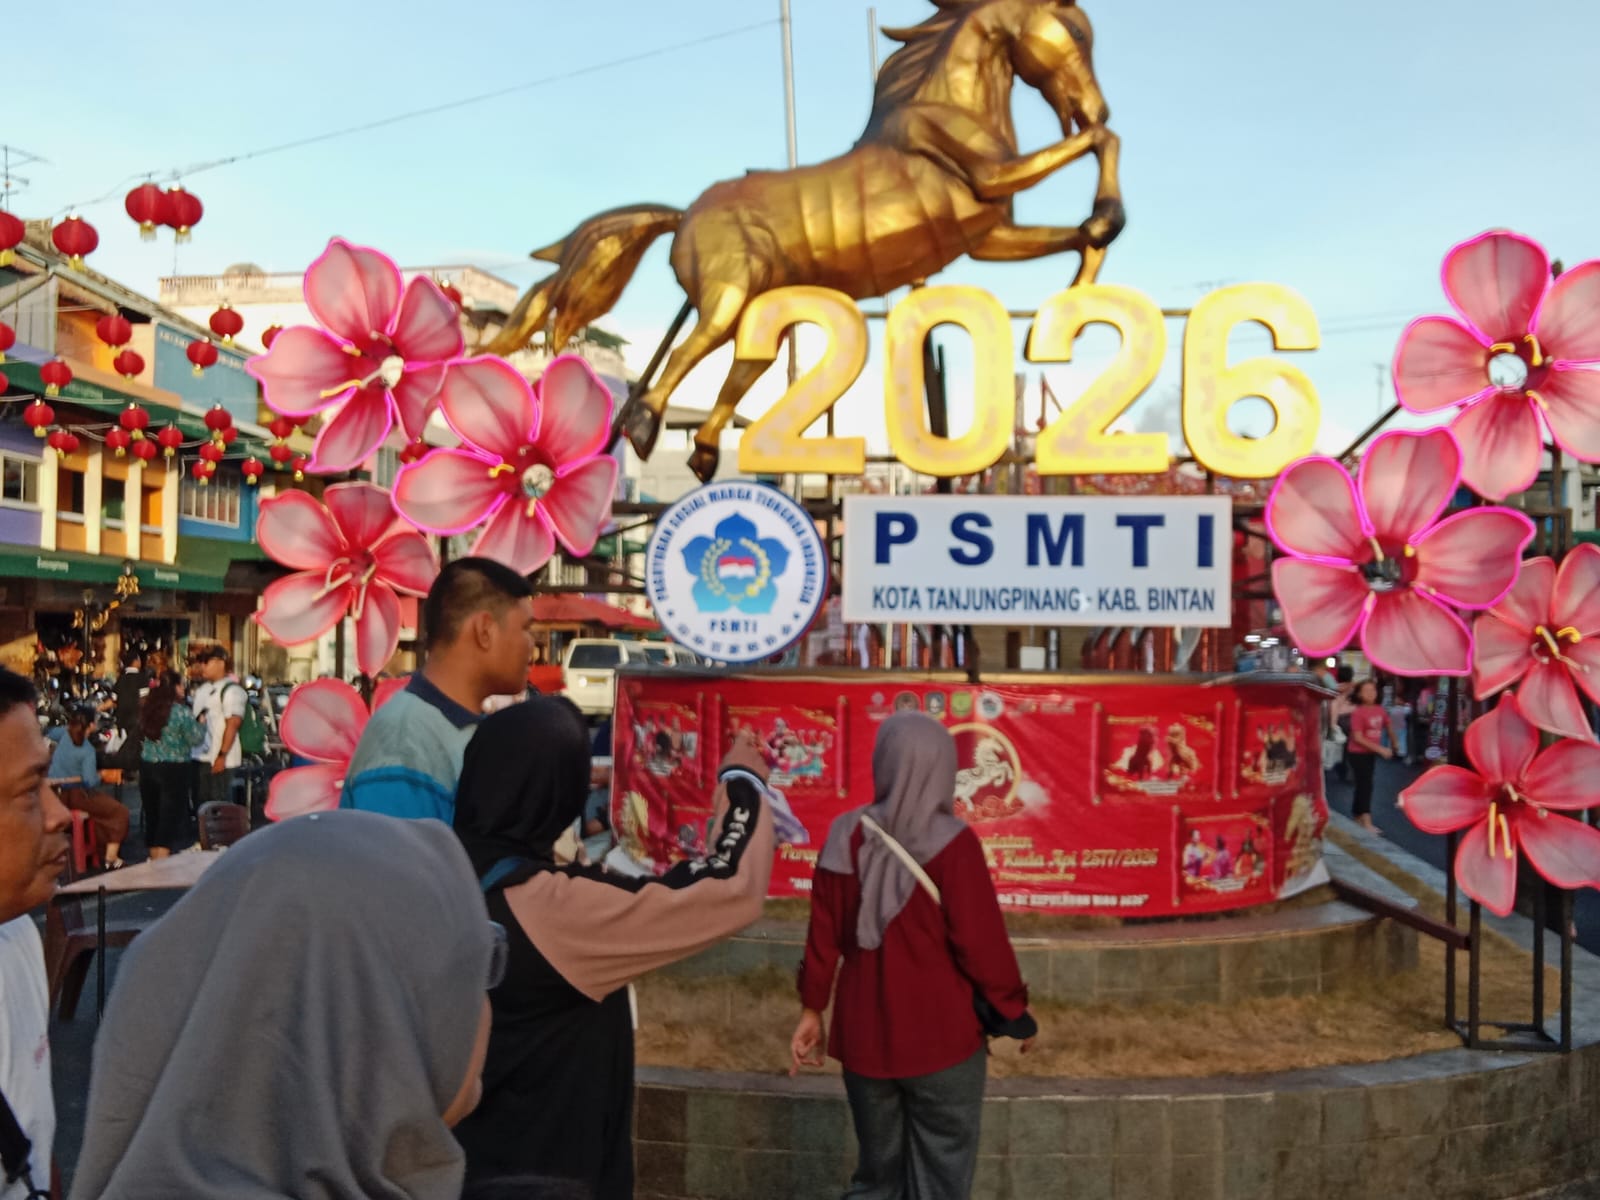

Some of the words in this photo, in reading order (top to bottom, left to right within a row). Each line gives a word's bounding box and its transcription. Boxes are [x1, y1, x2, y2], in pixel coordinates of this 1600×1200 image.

[735, 283, 1321, 478] 2026
[874, 511, 1214, 568] PSMTI
[873, 586, 922, 610] KOTA
[928, 586, 1081, 612] TANJUNGPINANG
[1099, 587, 1140, 611] KAB.
[1149, 587, 1214, 612] BINTAN
[710, 620, 758, 632] PSMTI
